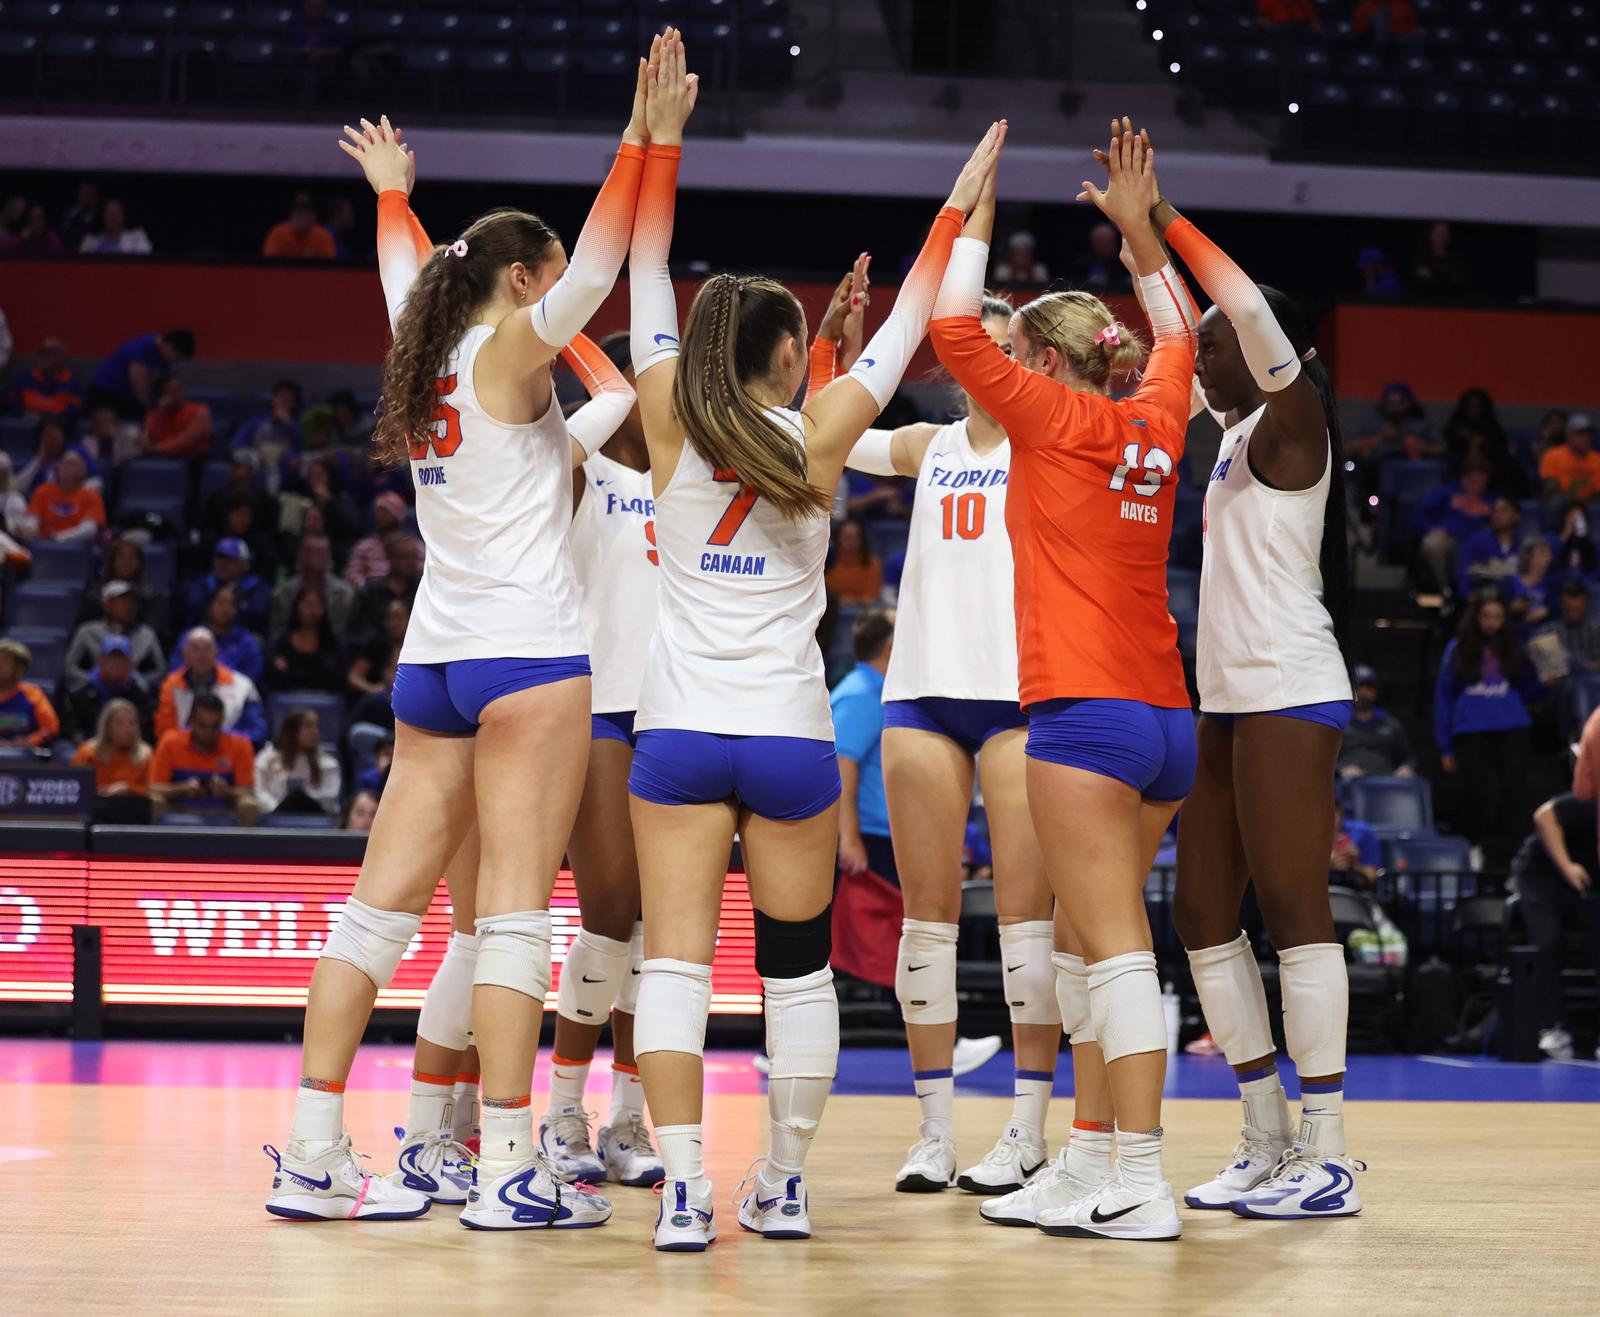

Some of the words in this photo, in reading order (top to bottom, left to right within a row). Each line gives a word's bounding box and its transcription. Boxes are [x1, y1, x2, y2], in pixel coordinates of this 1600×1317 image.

[406, 371, 464, 460] 5
[418, 466, 447, 486] ROTHE
[1108, 442, 1173, 498] 13
[706, 465, 761, 547] 7
[940, 492, 987, 541] 10
[1120, 500, 1158, 524] HAYES
[700, 552, 767, 576] CANAAN
